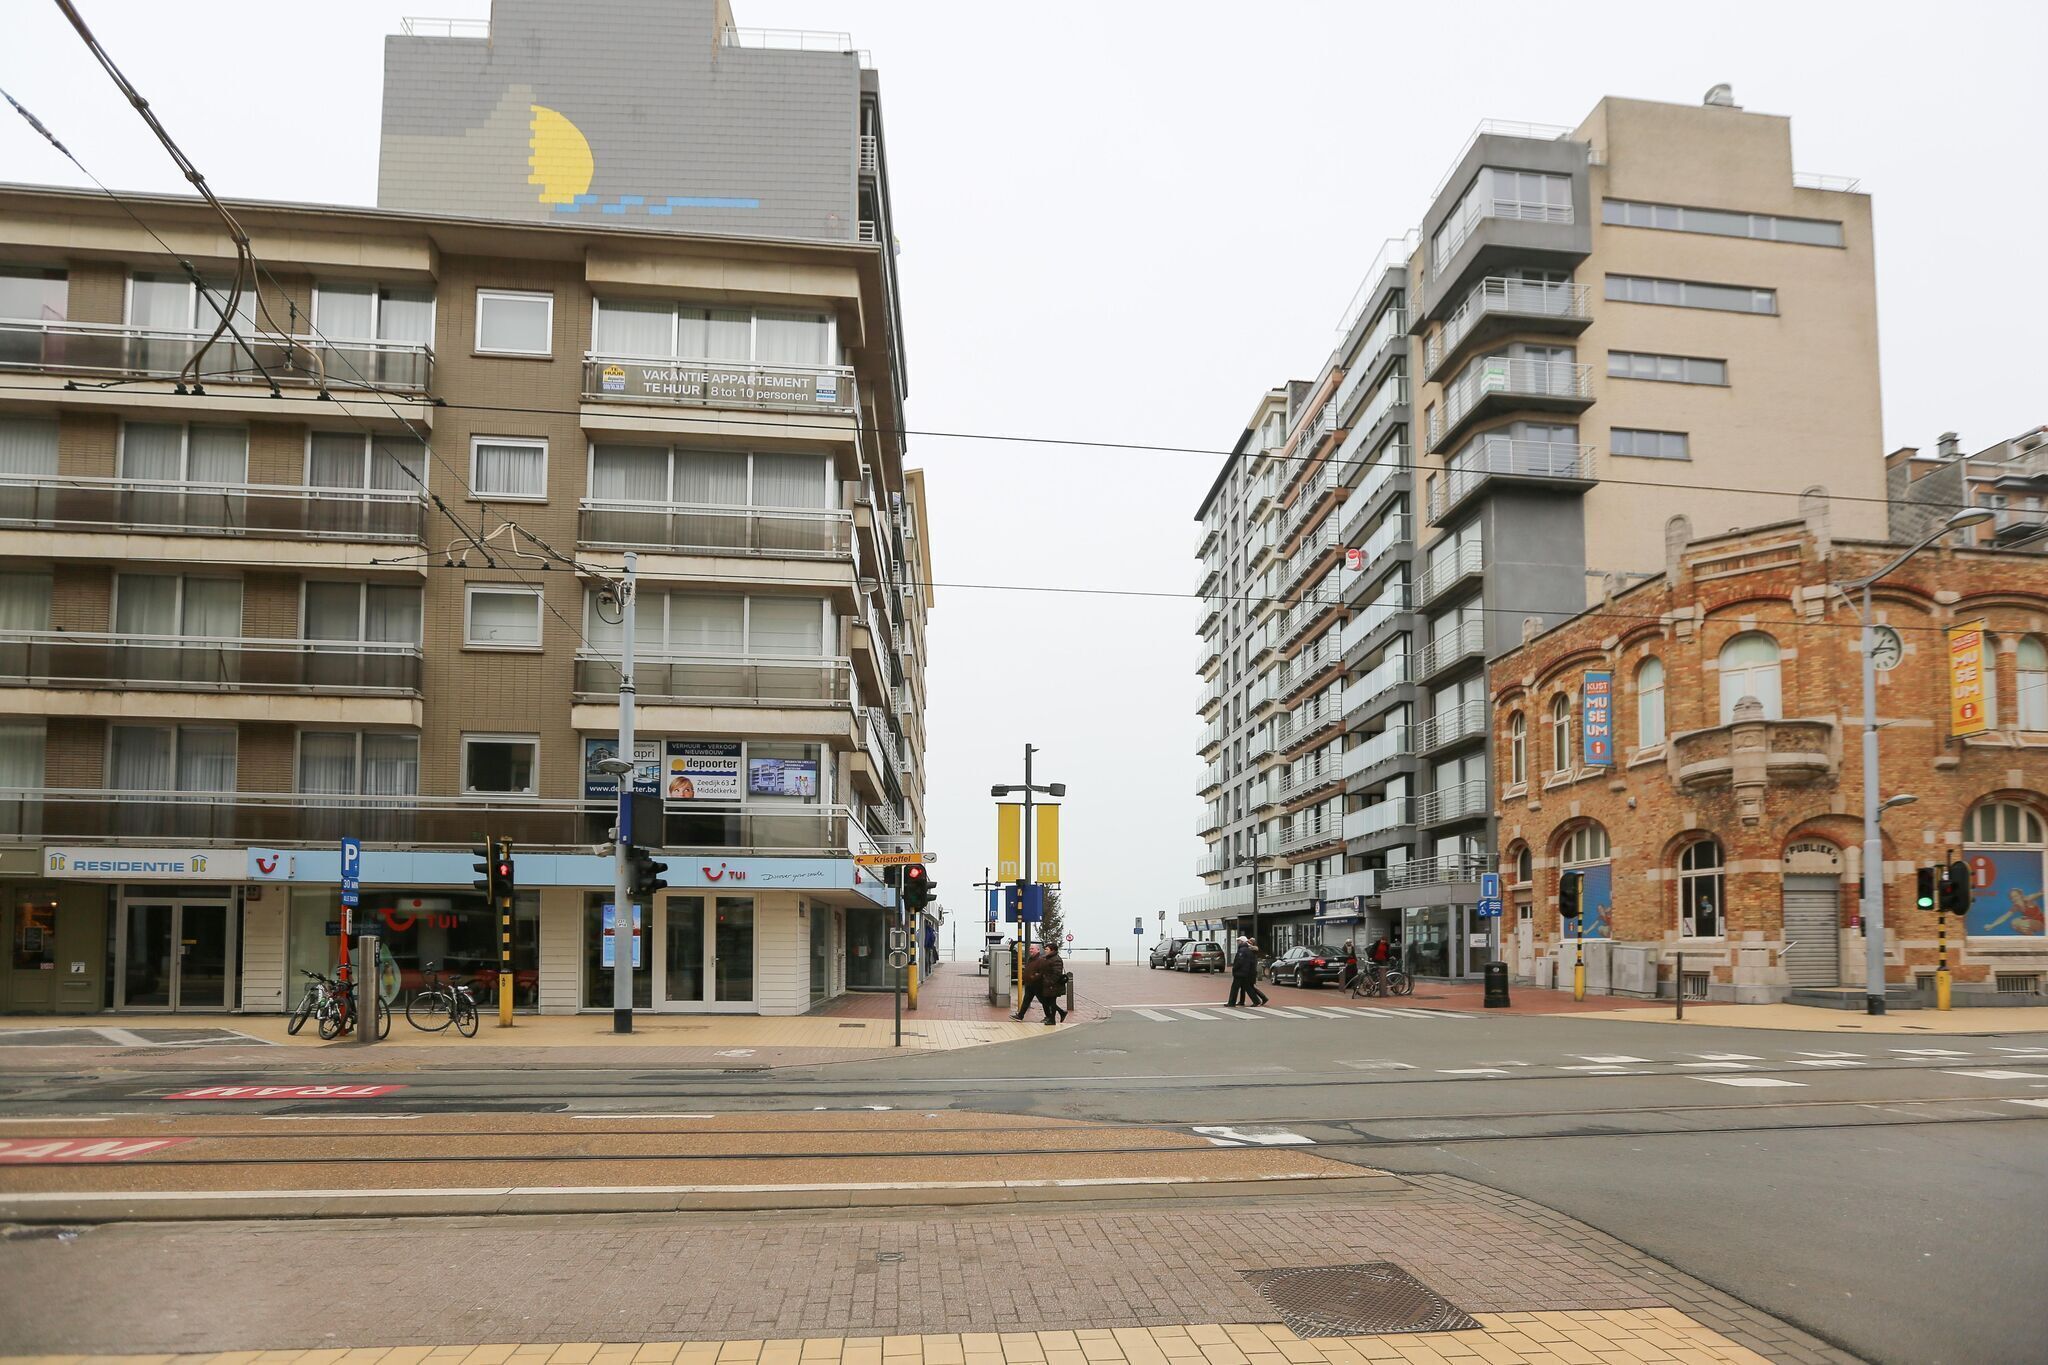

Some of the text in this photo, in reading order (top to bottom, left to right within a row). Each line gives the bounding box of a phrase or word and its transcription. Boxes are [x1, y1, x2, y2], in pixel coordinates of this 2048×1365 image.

[642, 369, 810, 388] VAKANTIE APPARTEMENT
[643, 382, 809, 401] TE HUUR 8 tot 10 personen
[1586, 681, 1608, 691] KUST
[1586, 696, 1608, 709] MU
[1588, 709, 1607, 723] SE
[1586, 724, 1608, 737] UM
[633, 749, 656, 760] apri
[686, 757, 738, 770] depoorter
[589, 784, 657, 793] www.derter.be
[696, 779, 721, 787] Zeedijk
[1788, 843, 1834, 855] PUBLIEK
[345, 843, 358, 871] P
[873, 855, 911, 863] Kristoffel
[73, 861, 185, 873] RESIDENTIE
[1001, 861, 1017, 875] m
[1040, 862, 1057, 876] m
[728, 871, 746, 880] TUI
[343, 880, 351, 889] 30
[425, 912, 459, 929] TUI
[184, 1085, 383, 1097] TRAM
[0, 1140, 171, 1158] AM
